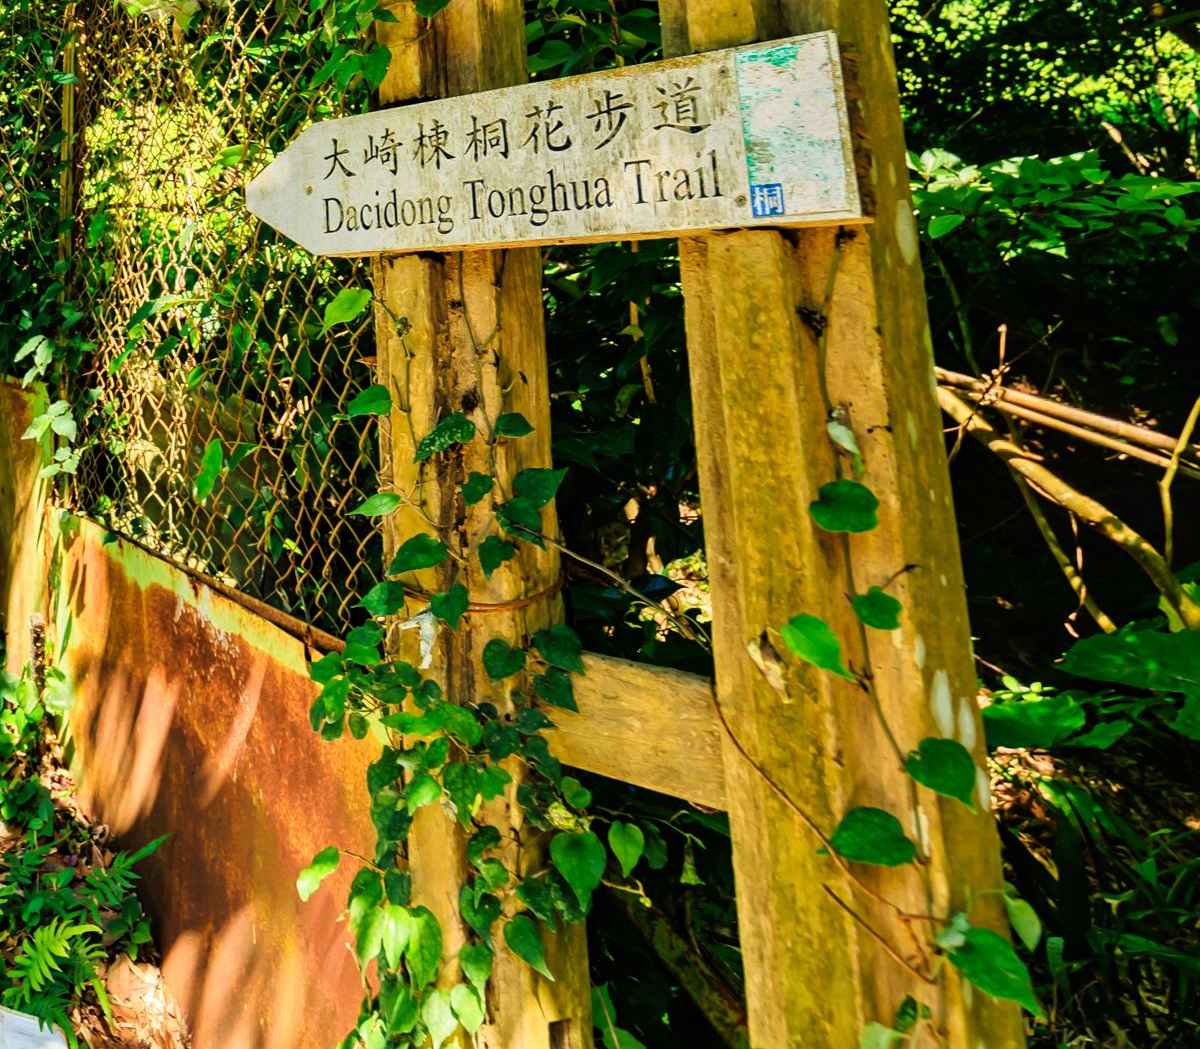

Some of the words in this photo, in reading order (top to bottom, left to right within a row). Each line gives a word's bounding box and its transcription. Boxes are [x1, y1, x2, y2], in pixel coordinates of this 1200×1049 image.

[322, 76, 712, 181] 大崎棟桐花步道
[323, 184, 454, 234] Dacidong
[463, 169, 613, 226] Tonghua
[624, 150, 725, 204] Trail
